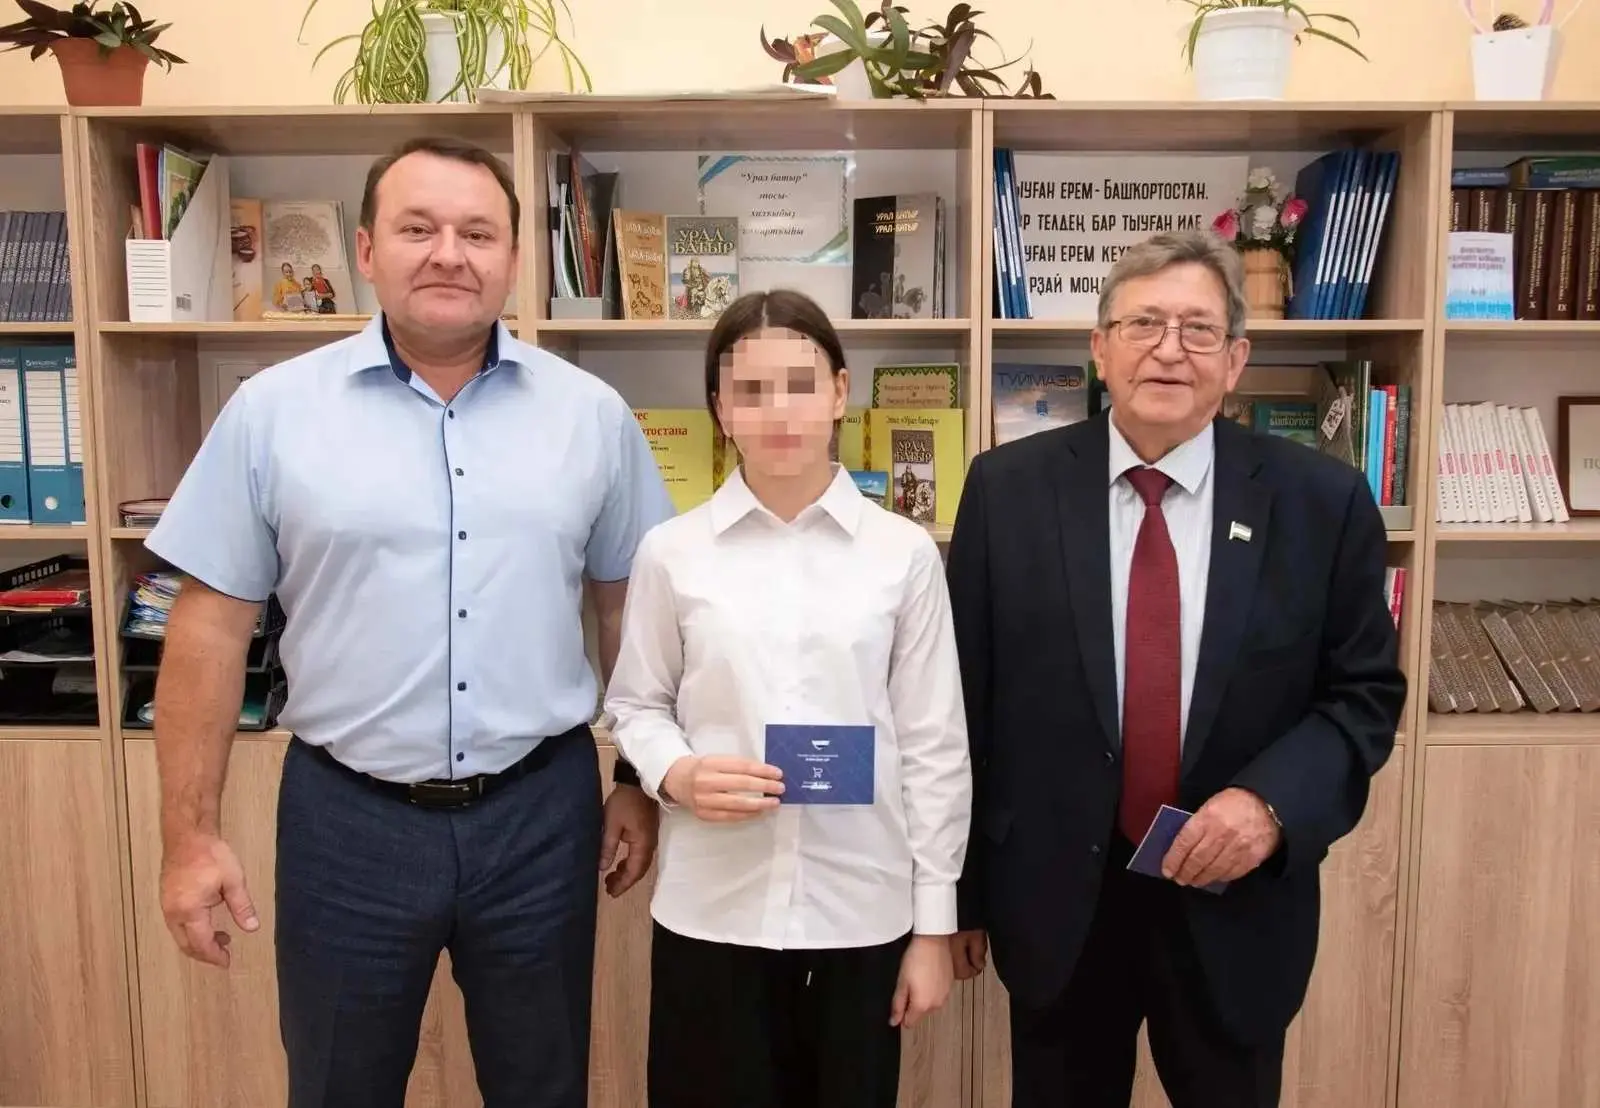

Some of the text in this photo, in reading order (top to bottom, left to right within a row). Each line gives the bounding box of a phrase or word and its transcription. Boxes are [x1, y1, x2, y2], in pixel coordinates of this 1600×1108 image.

[1016, 181, 1055, 200] ЫУҒАН
[1092, 214, 1116, 232] БАР
[679, 228, 724, 242] УРАЛ
[675, 240, 735, 255] БАТЫР
[1061, 245, 1095, 262] ЕРЕМ
[997, 370, 1082, 389] ТУЙМАЗЫ
